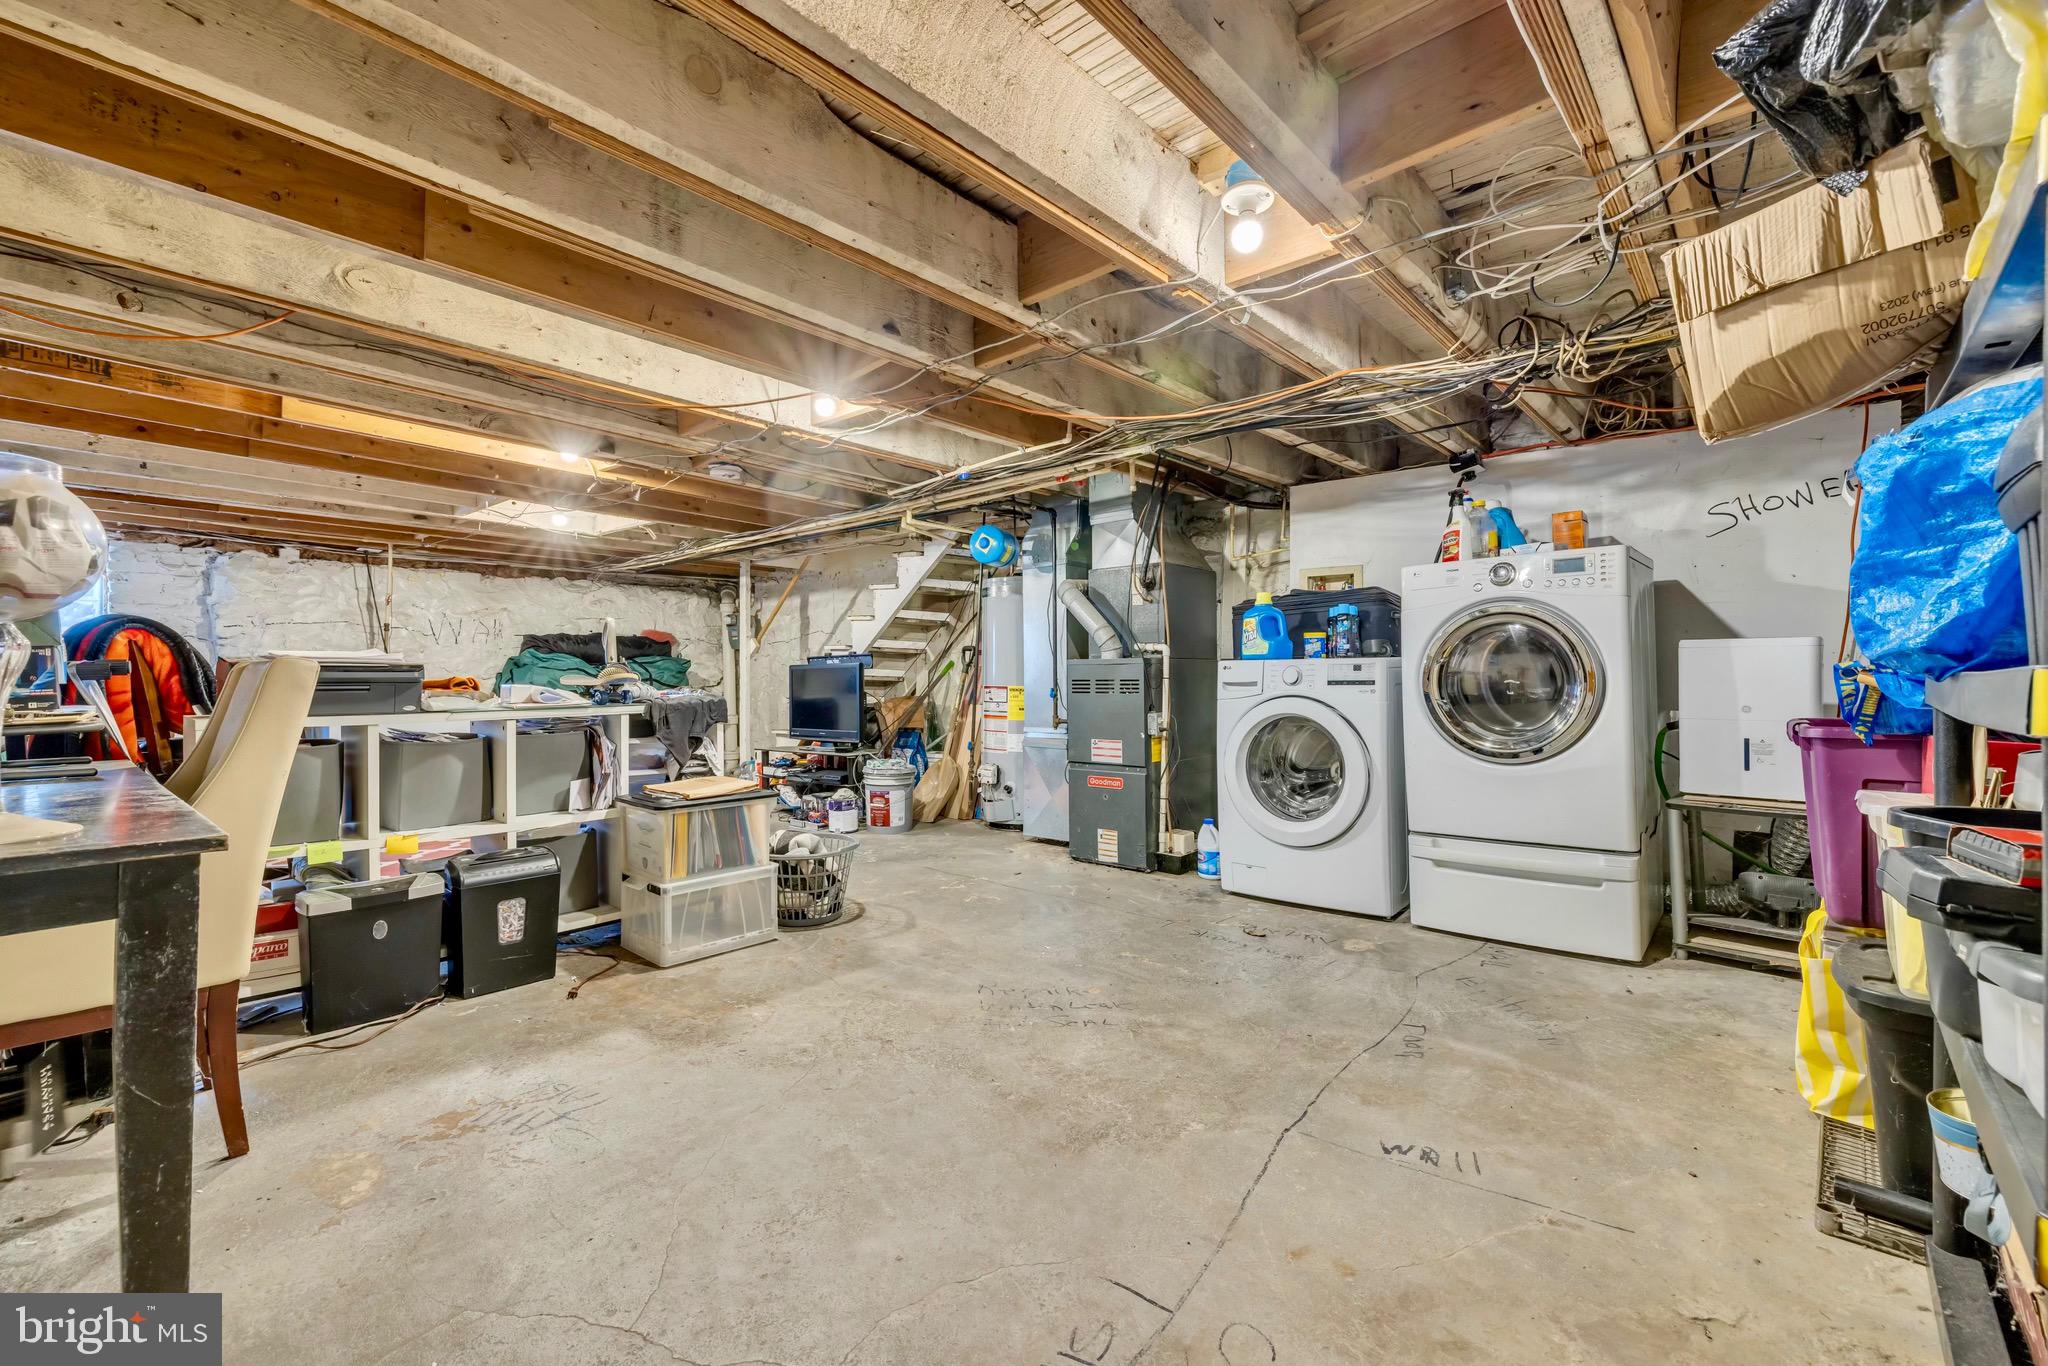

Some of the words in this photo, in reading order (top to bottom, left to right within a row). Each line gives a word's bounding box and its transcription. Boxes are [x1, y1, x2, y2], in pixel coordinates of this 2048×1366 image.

[1912, 281, 1946, 301] (new)
[1879, 295, 1909, 312] 2023
[1861, 301, 1946, 335] 507792002
[1090, 777, 1121, 788] Goodman
[251, 943, 288, 958] parco
